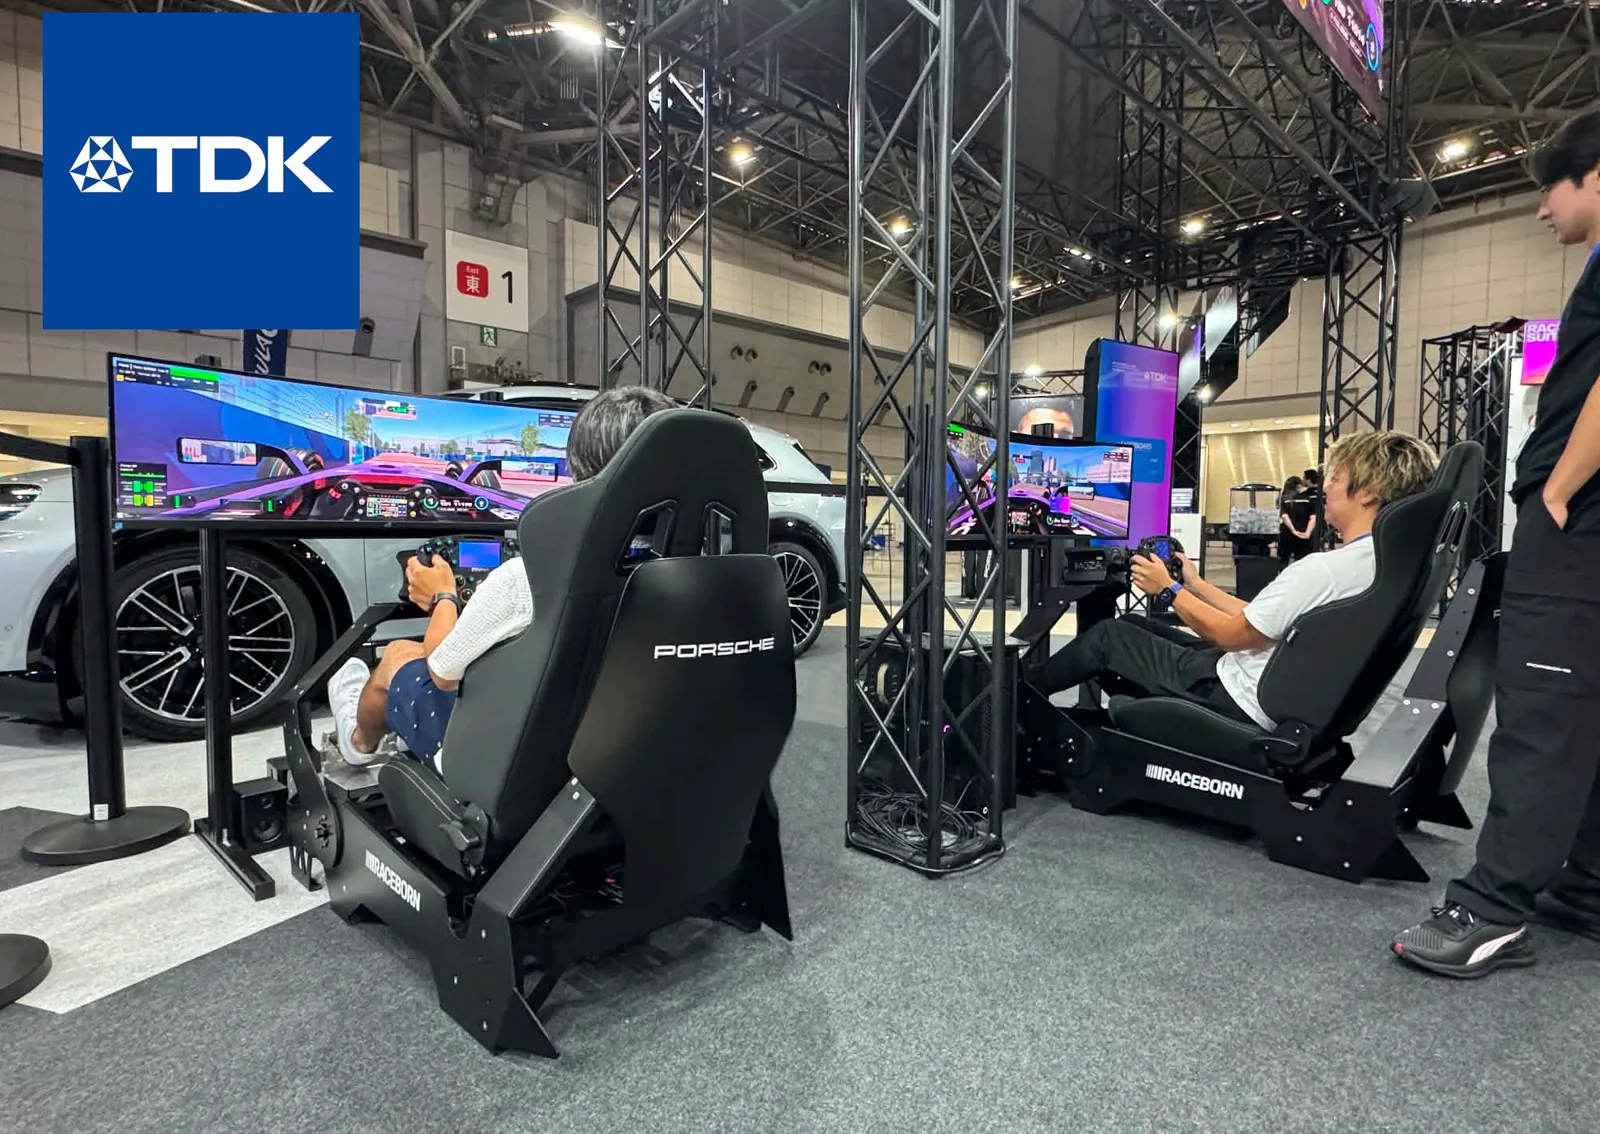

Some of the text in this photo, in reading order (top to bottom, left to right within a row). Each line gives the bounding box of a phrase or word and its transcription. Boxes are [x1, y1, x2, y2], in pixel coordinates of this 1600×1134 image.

[465, 275, 481, 294] 東
[501, 270, 513, 304] 1
[654, 637, 775, 659] PORSCHE
[1161, 767, 1244, 800] RACEBORN
[374, 855, 421, 912] RACEBORN
